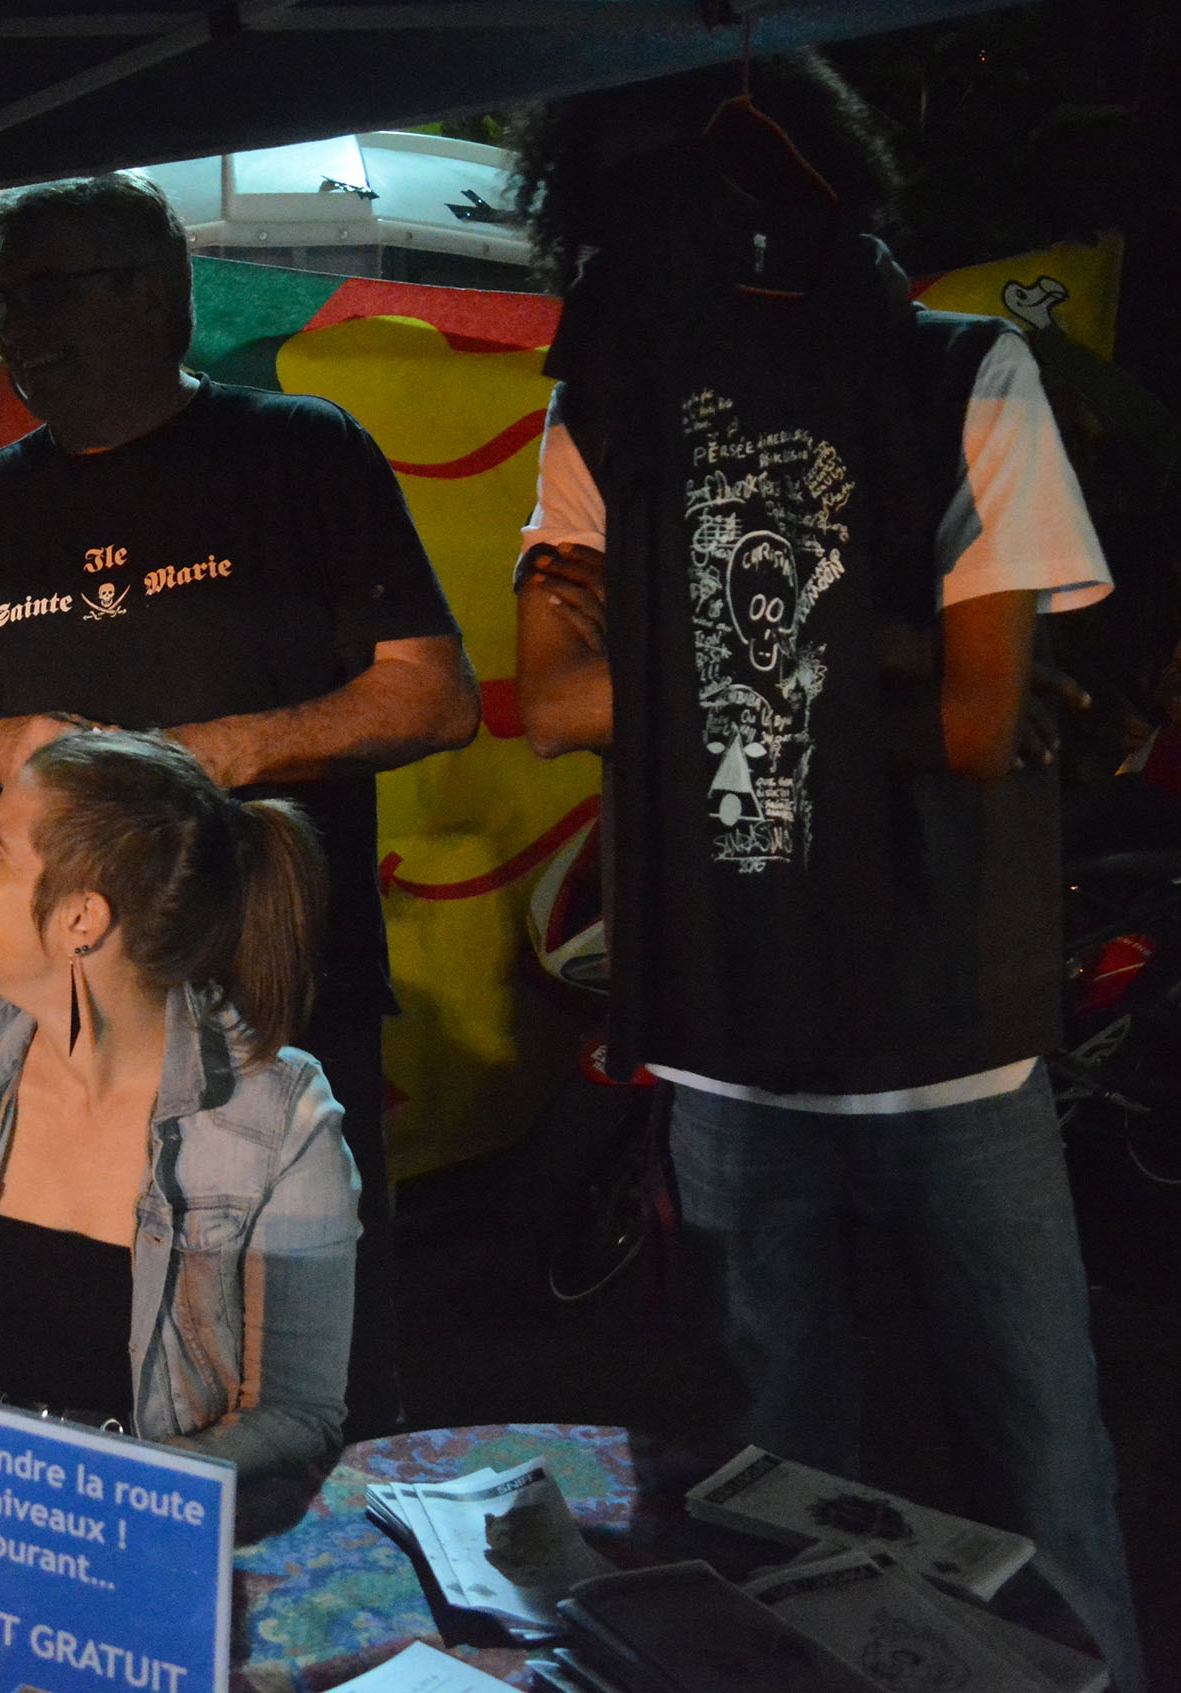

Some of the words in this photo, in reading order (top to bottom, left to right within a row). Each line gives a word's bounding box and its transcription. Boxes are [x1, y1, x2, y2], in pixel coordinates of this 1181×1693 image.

[143, 554, 233, 596] Marie
[77, 1465, 104, 1500] la
[116, 1481, 206, 1526] route
[117, 1519, 128, 1550] !
[30, 1624, 188, 1693] GRATUIT
